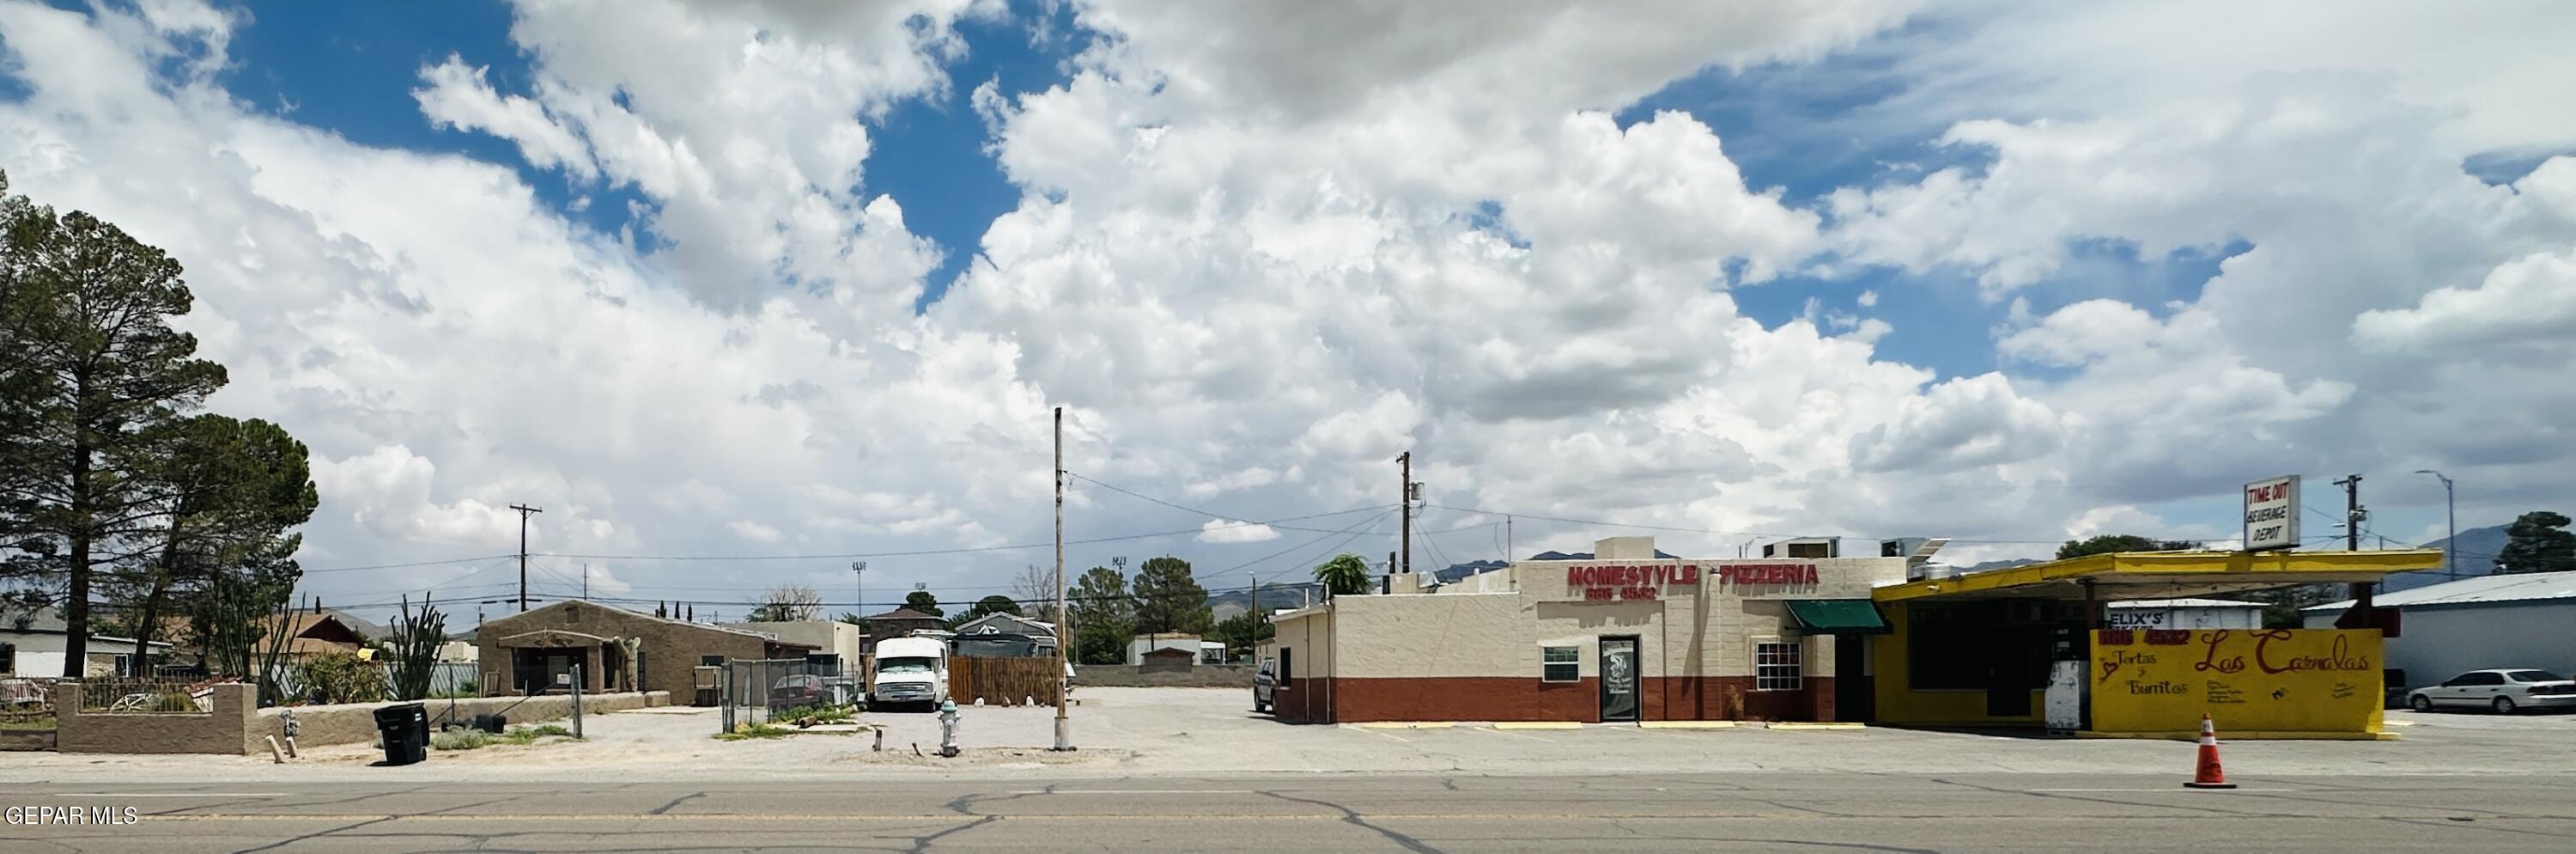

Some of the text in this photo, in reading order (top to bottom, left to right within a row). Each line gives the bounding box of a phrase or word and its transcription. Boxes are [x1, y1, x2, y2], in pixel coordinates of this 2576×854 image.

[2248, 481, 2288, 504] TIME OUT
[2246, 505, 2287, 523] BEVERAGE
[2253, 525, 2282, 540] DEPOT
[1568, 565, 1698, 585] HOMESTYLE
[1719, 564, 1819, 585] PIZZERIA
[2112, 650, 2157, 665] Tortas
[2126, 680, 2189, 694] Burritos
